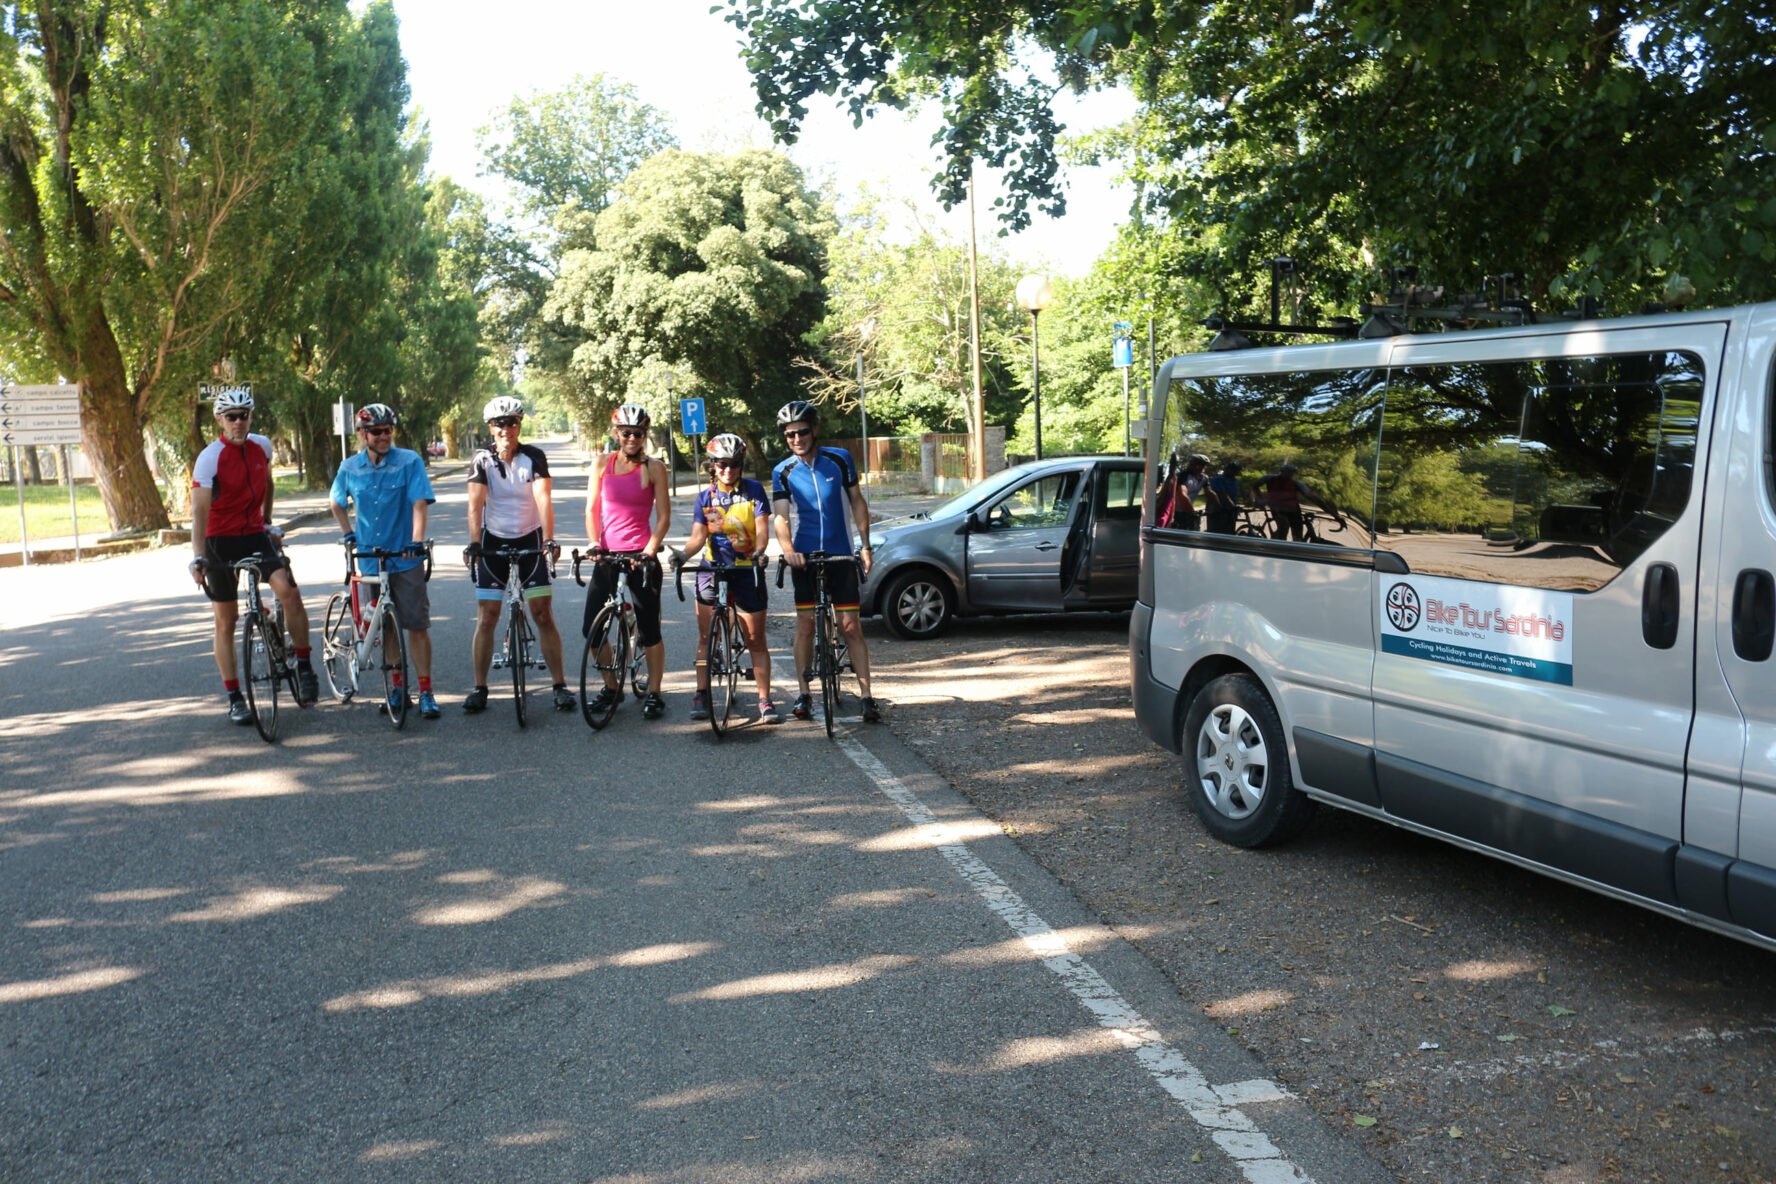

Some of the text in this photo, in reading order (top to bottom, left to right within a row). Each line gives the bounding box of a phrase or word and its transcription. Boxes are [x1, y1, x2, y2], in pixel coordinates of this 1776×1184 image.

[687, 402, 698, 417] P
[1426, 599, 1565, 642] Bike Tour Sardinia
[1426, 625, 1444, 633] Nice
[1454, 629, 1470, 637] Bike
[1471, 631, 1486, 640] You
[1409, 640, 1537, 669] Cycling Holidays and Active Travels
[1430, 654, 1513, 672] www.biketoursardinia.com
